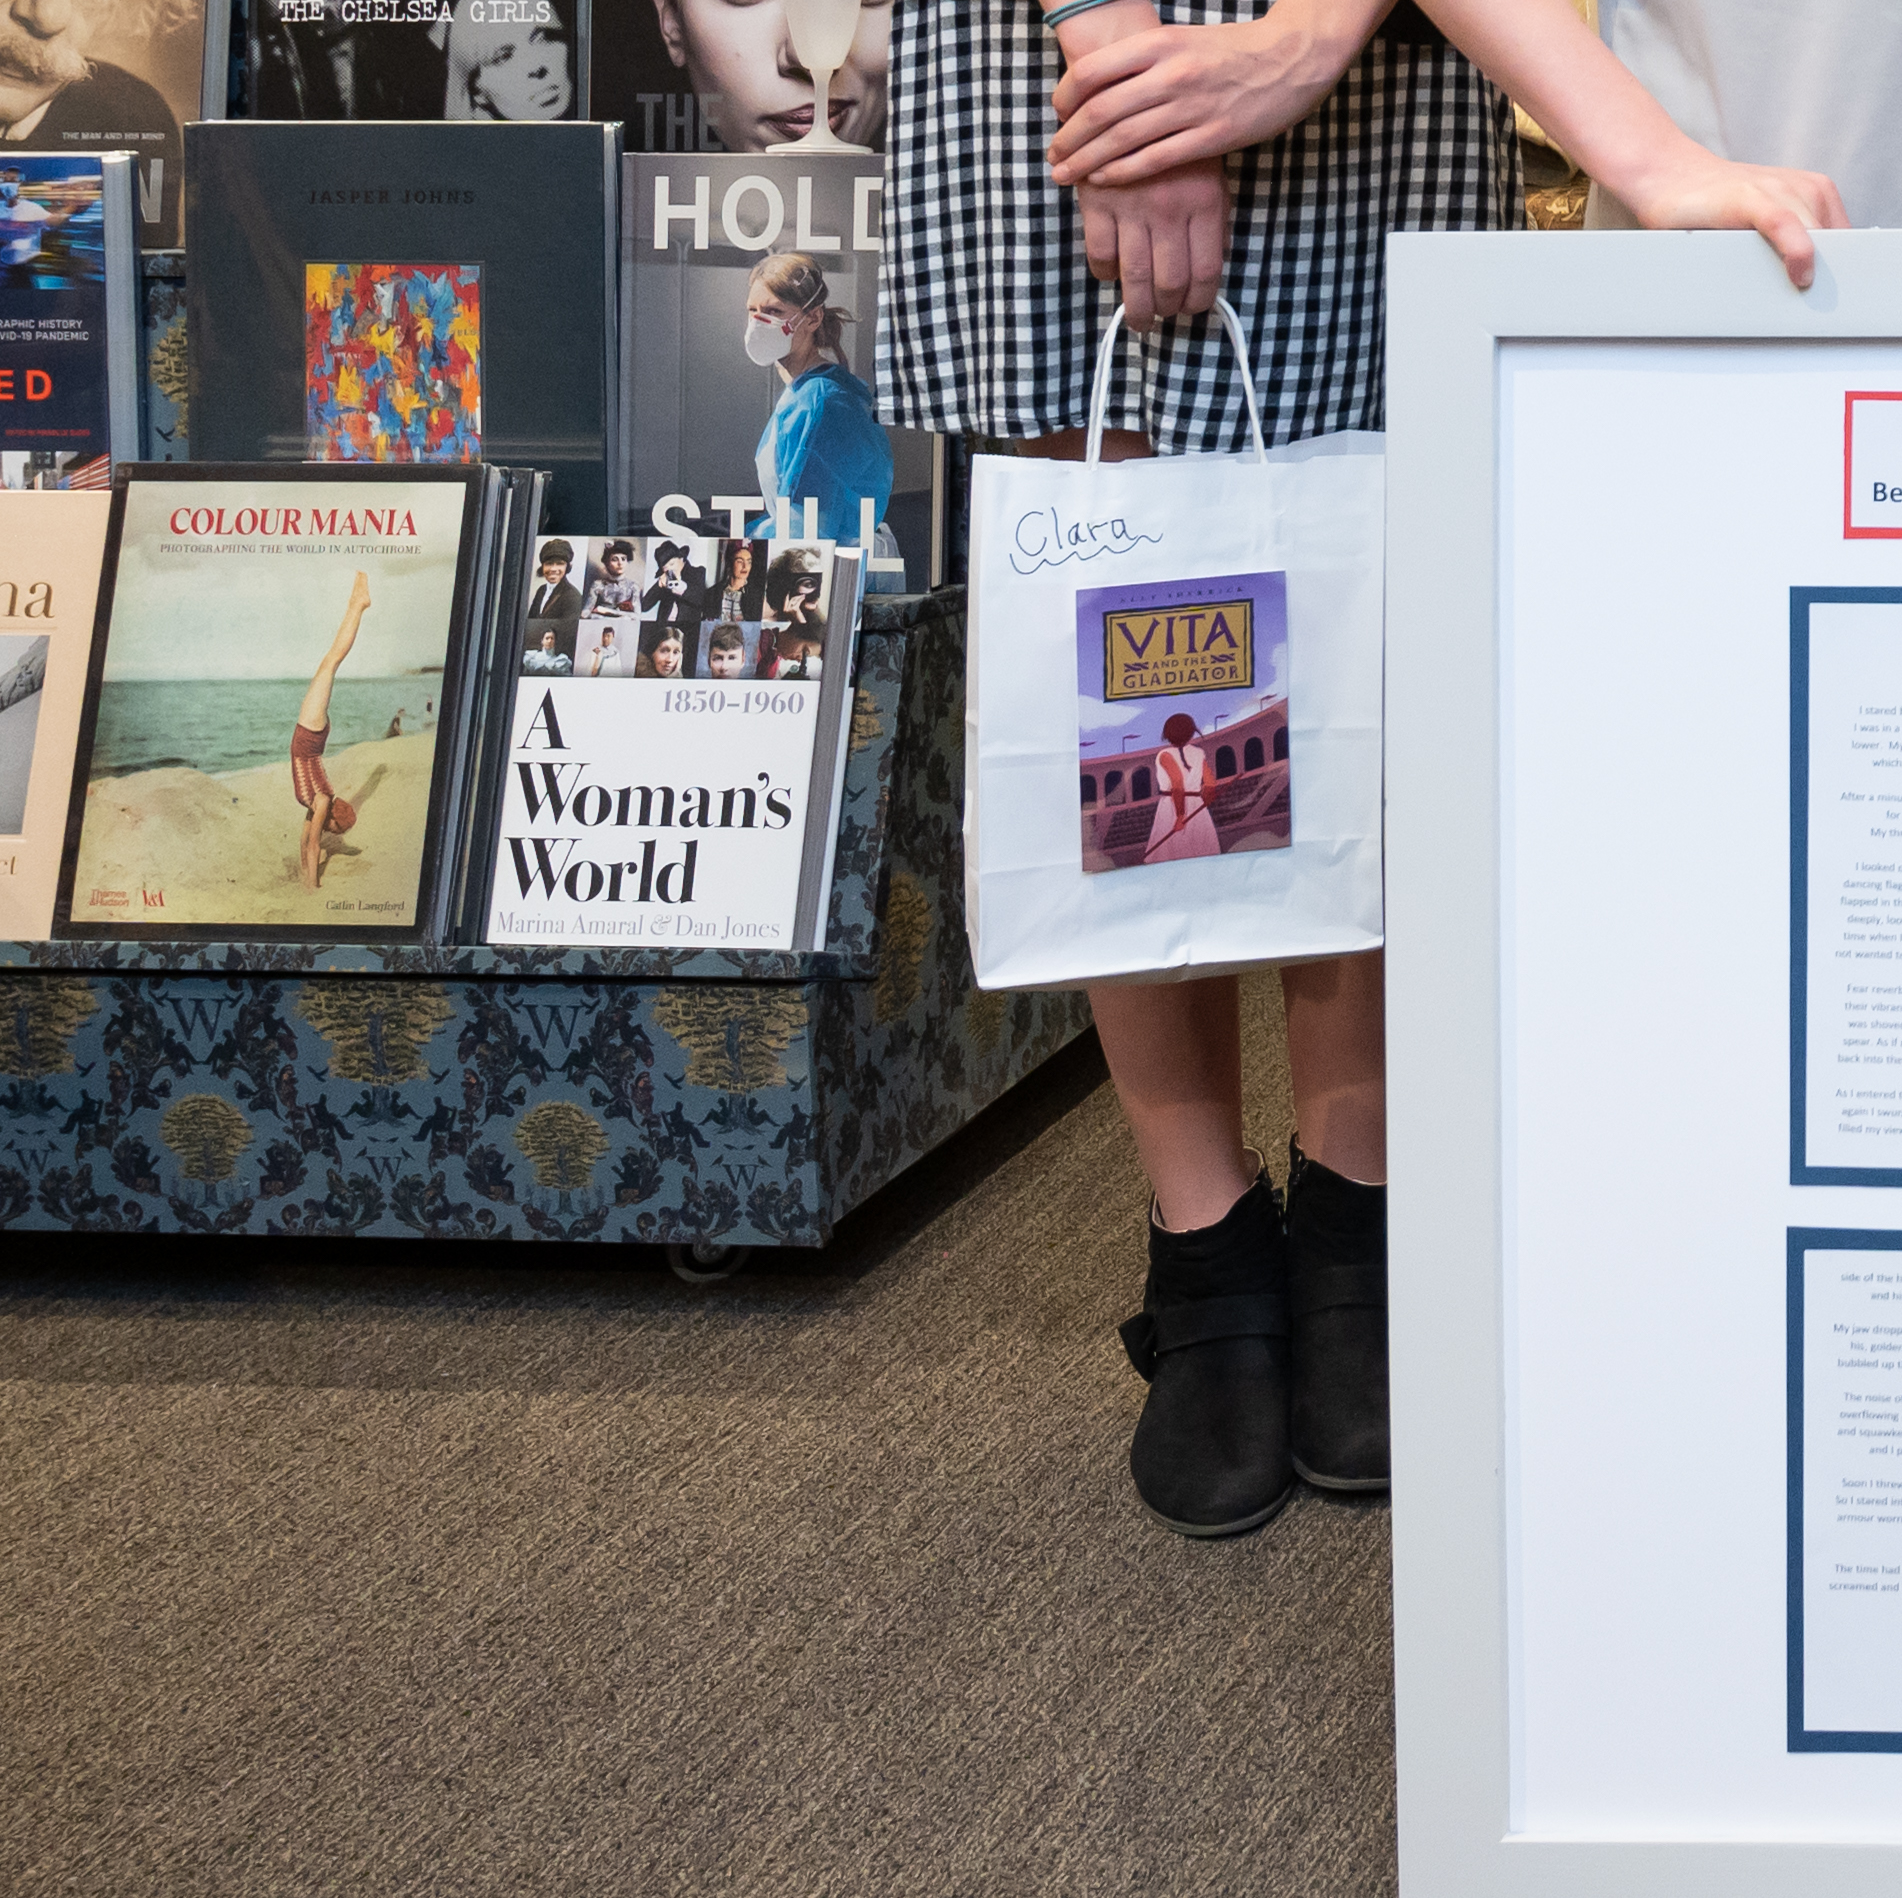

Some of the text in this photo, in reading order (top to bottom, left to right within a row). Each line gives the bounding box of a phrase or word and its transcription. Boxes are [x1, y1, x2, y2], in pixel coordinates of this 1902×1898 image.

[279, 0, 326, 23] THE
[636, 93, 724, 152] THE
[62, 131, 165, 140] THE MAN AND HIS MIND
[308, 188, 477, 206] JASPER JOHNS
[653, 175, 885, 251] HOLD
[35, 331, 90, 342] PANDEMIC
[38, 319, 83, 330] HISTORY
[169, 507, 418, 538] COLOUR MANIA
[1015, 505, 1138, 558] Clara
[160, 543, 422, 555] PHOTOGRAPHING THE WORLD IN AUTOCHROME
[1116, 610, 1240, 659] VITA
[1152, 656, 1207, 670] AND THE
[1123, 665, 1239, 689] GLADIATOR
[522, 688, 571, 750] A
[1865, 705, 1897, 716] stared
[514, 761, 793, 832] Woman's
[506, 839, 698, 905] World
[358, 900, 405, 913] Langford
[497, 911, 781, 938] Marina Amaral & Dan Jones
